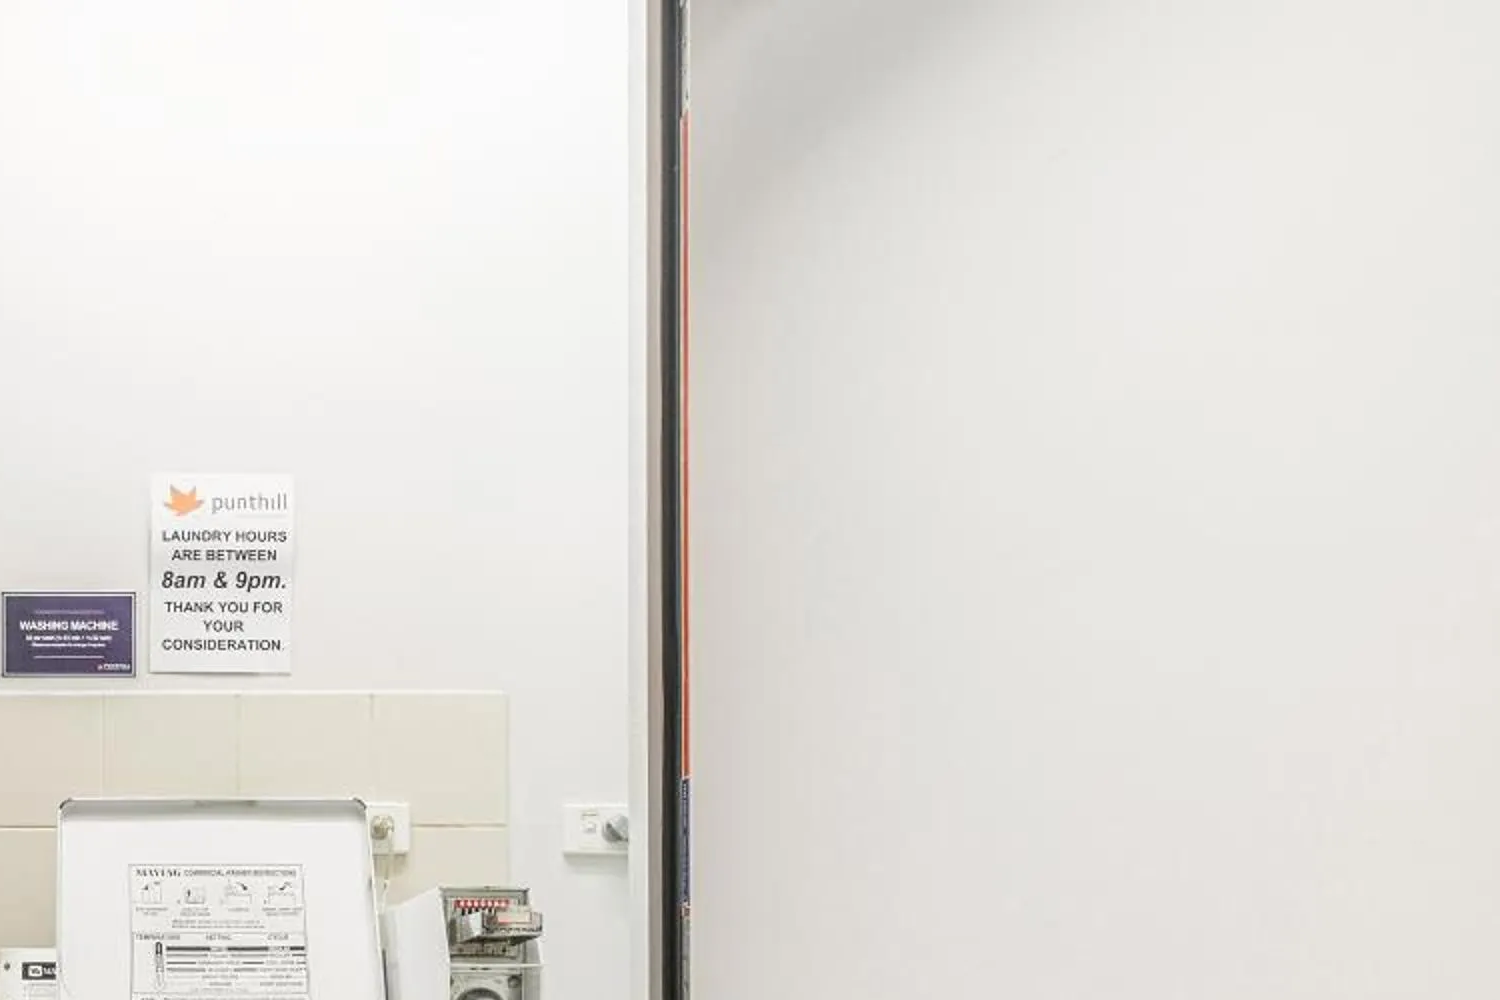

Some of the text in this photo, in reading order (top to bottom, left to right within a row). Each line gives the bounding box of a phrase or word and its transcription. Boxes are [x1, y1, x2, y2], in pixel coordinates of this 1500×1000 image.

[211, 492, 287, 515] punthill
[162, 530, 287, 542] LAUNDRY HOURS
[171, 549, 277, 561] ARE BETWEEN
[161, 571, 287, 593] 8am & 9pm.
[164, 601, 283, 613] THANK YOU FOR
[19, 620, 119, 631] WASHING MACHINE
[203, 620, 244, 632] YOUR
